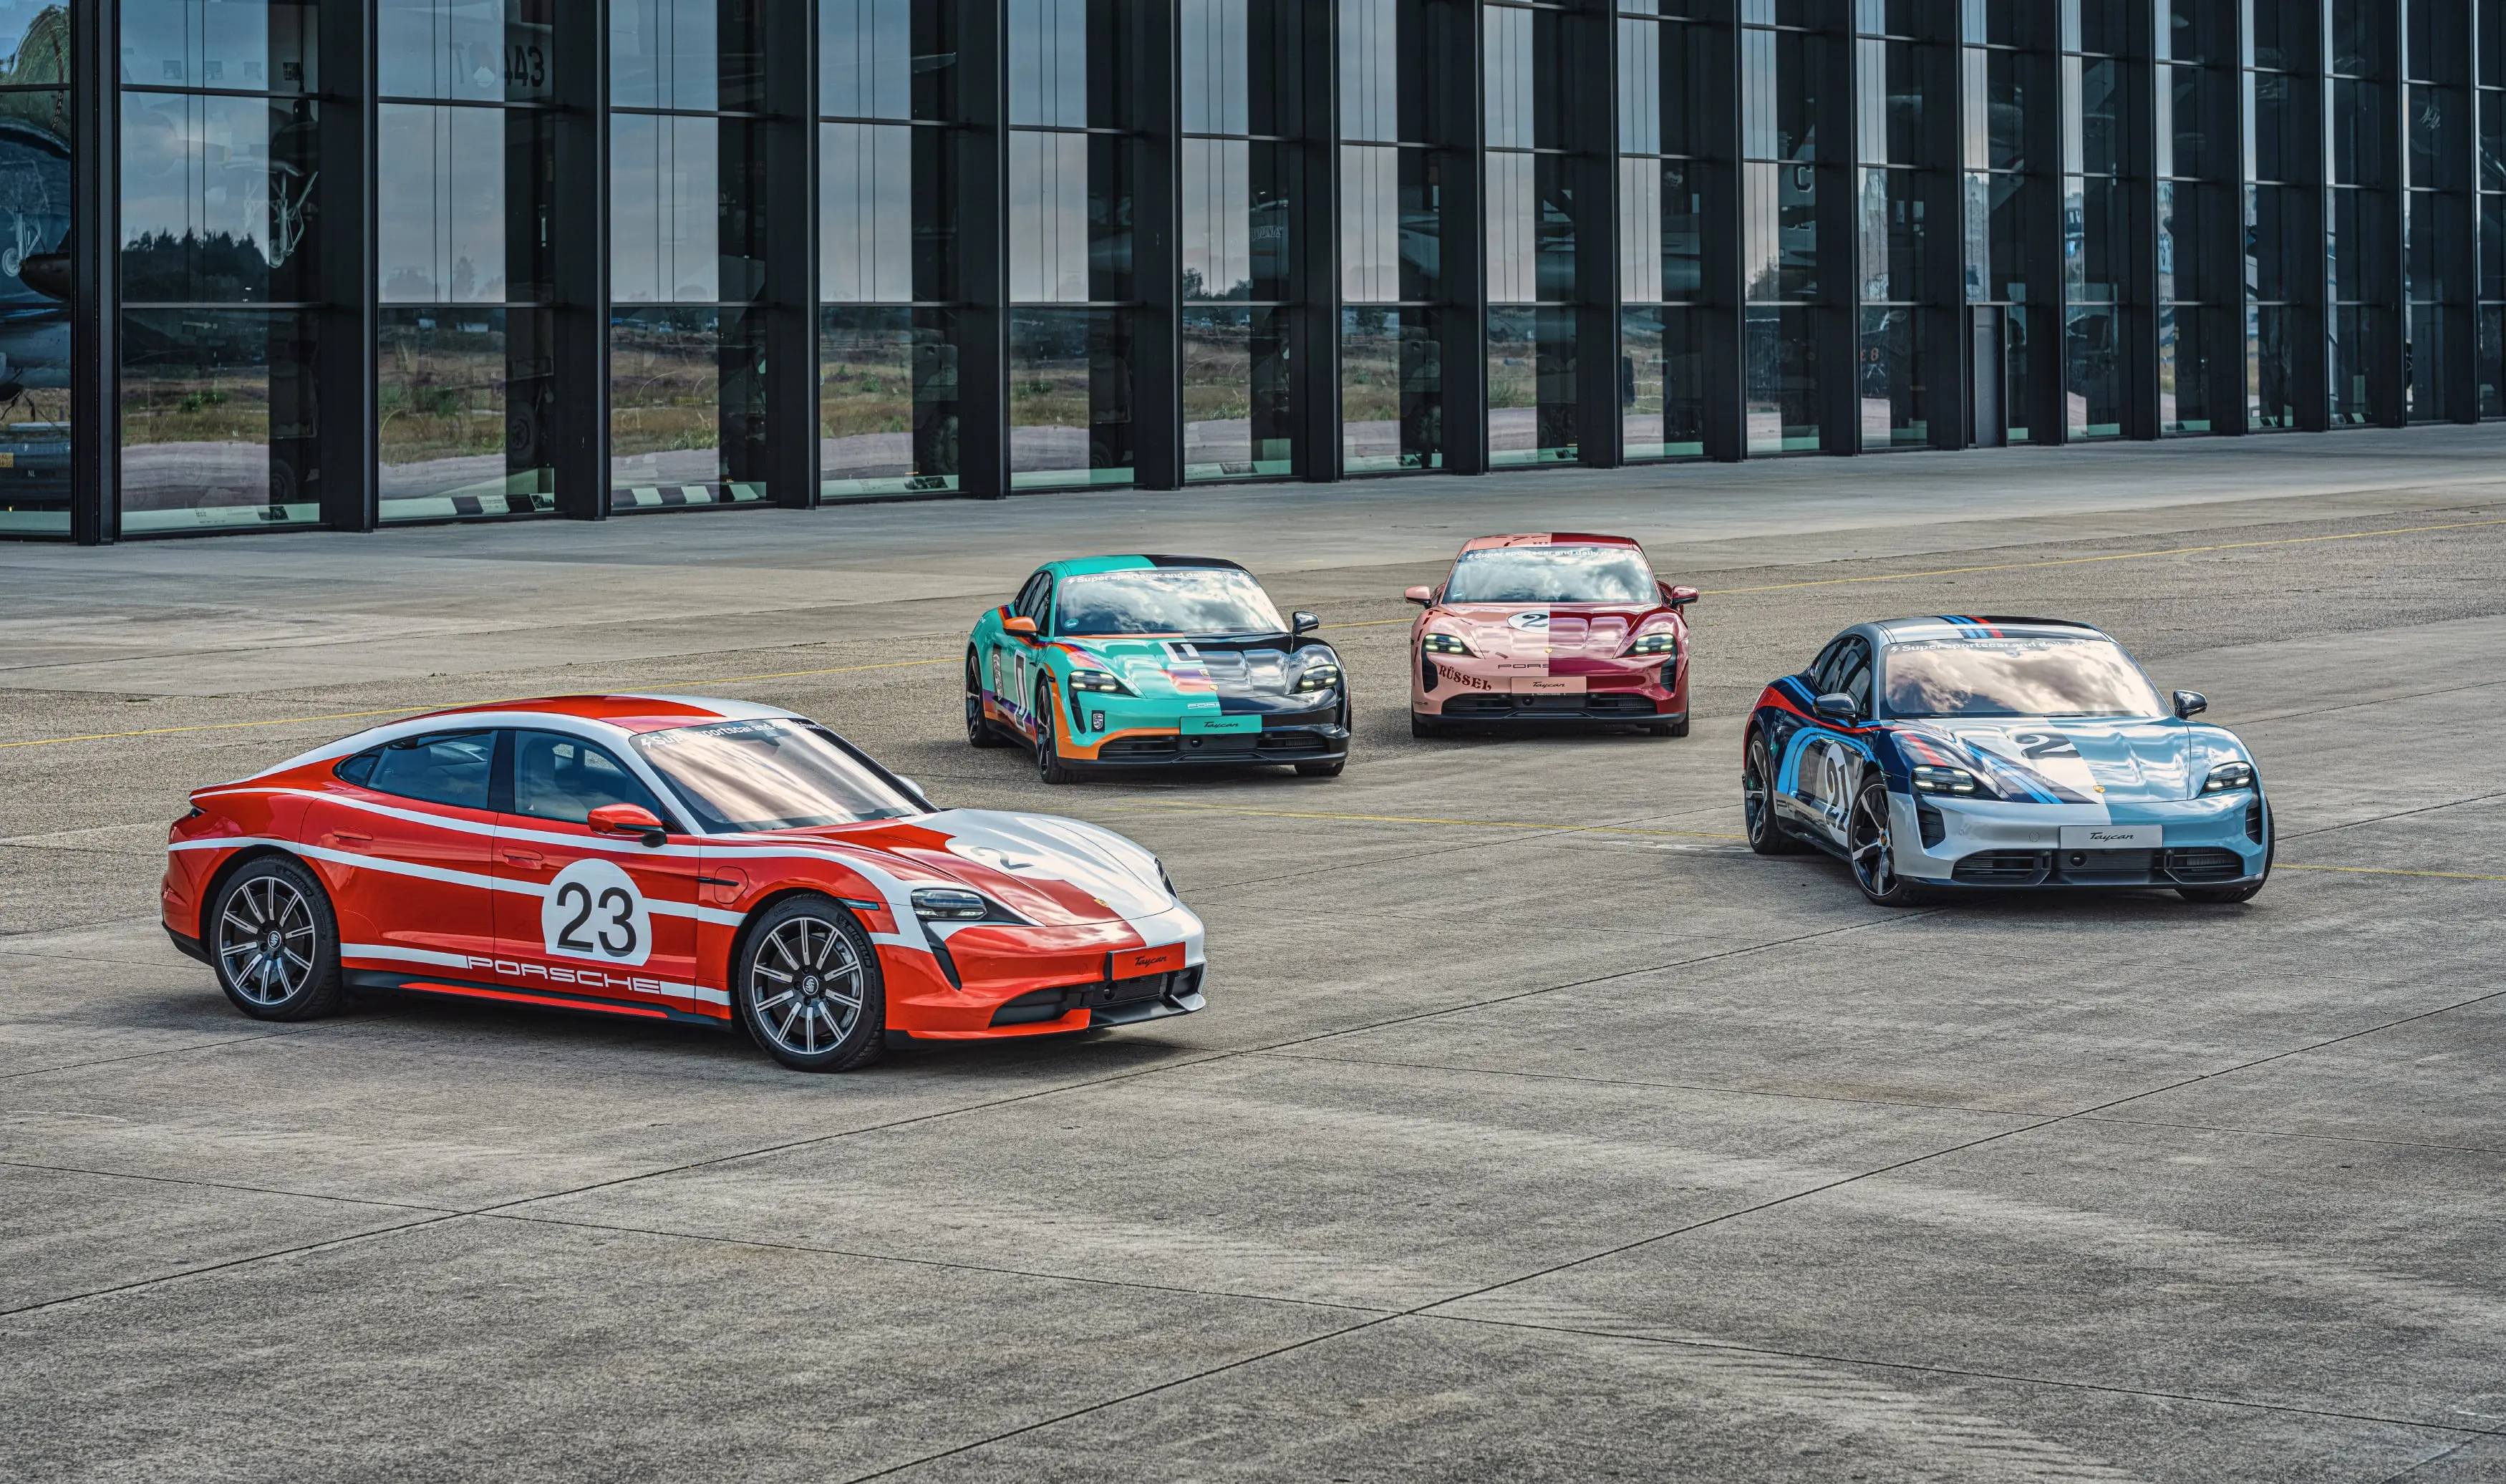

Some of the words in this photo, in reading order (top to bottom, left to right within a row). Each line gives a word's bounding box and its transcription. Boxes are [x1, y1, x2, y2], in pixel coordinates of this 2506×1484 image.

[28, 469, 36, 477] NL
[1522, 614, 1549, 628] 2
[1438, 664, 1492, 692] RÜSSEL
[652, 731, 689, 746] Sup
[697, 724, 753, 738] sportscar
[2015, 732, 2082, 760] 2
[1825, 757, 1849, 833] 21
[2089, 831, 2135, 843] Taycan
[969, 846, 1035, 870] 2
[556, 881, 637, 957] 23
[1134, 956, 1167, 969] Taycan
[467, 956, 660, 994] PORSCHE
